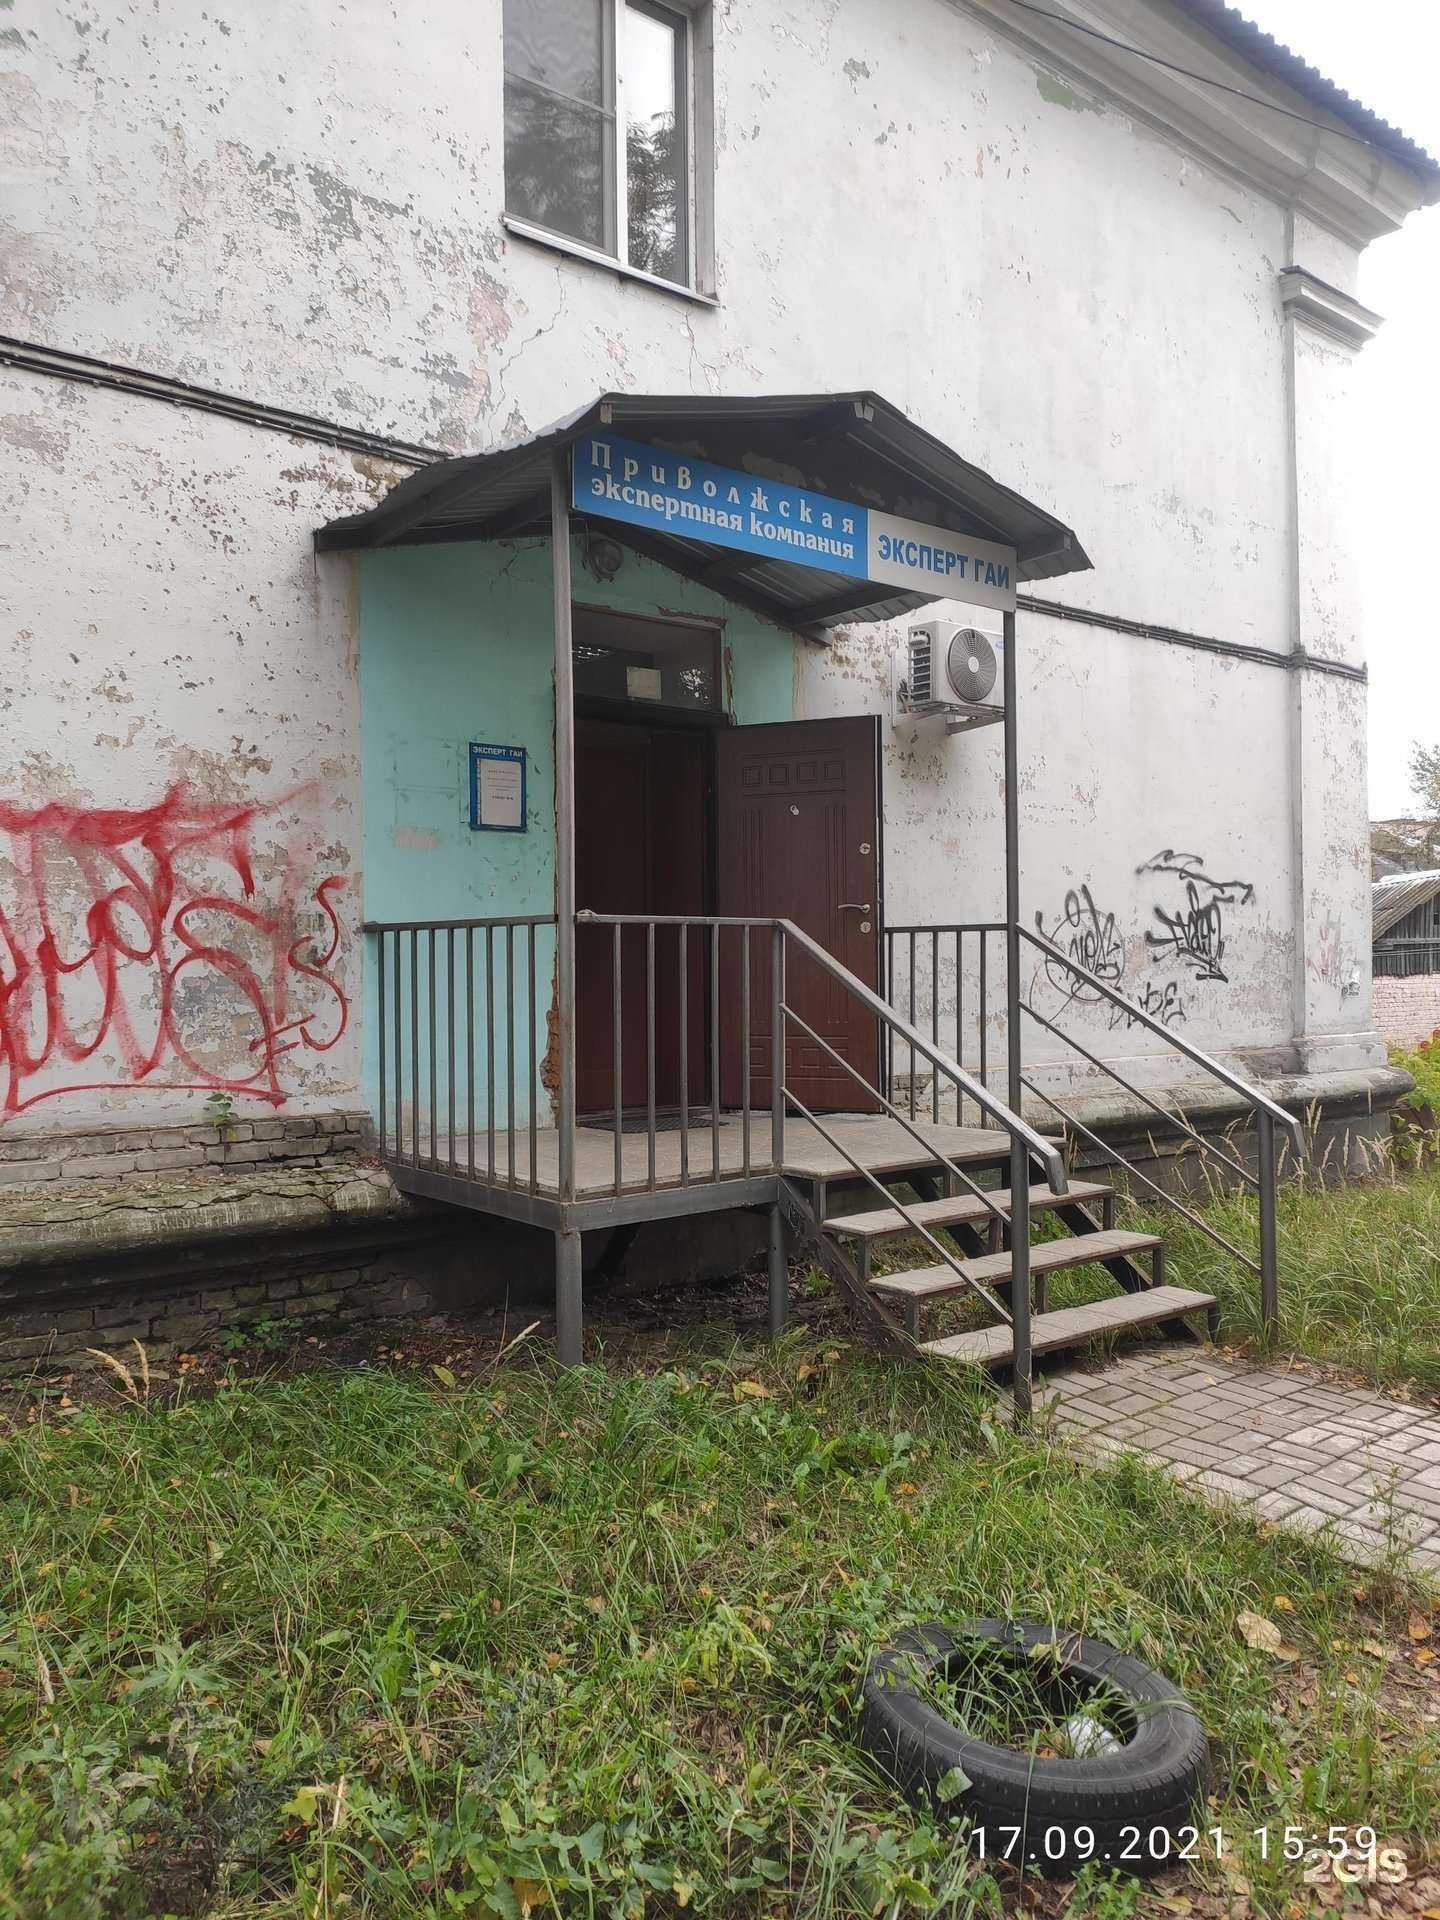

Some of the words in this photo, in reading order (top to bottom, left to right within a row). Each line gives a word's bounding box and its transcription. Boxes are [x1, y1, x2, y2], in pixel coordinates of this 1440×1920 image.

[590, 440, 855, 534] Приволжская
[591, 473, 743, 532] экспертная
[749, 513, 855, 560] компания
[877, 534, 969, 578] ЭКСПЕРТ
[974, 557, 1010, 590] ГАИ
[472, 746, 506, 756] ЭКСПЕРТ
[509, 750, 523, 758] ГАИ
